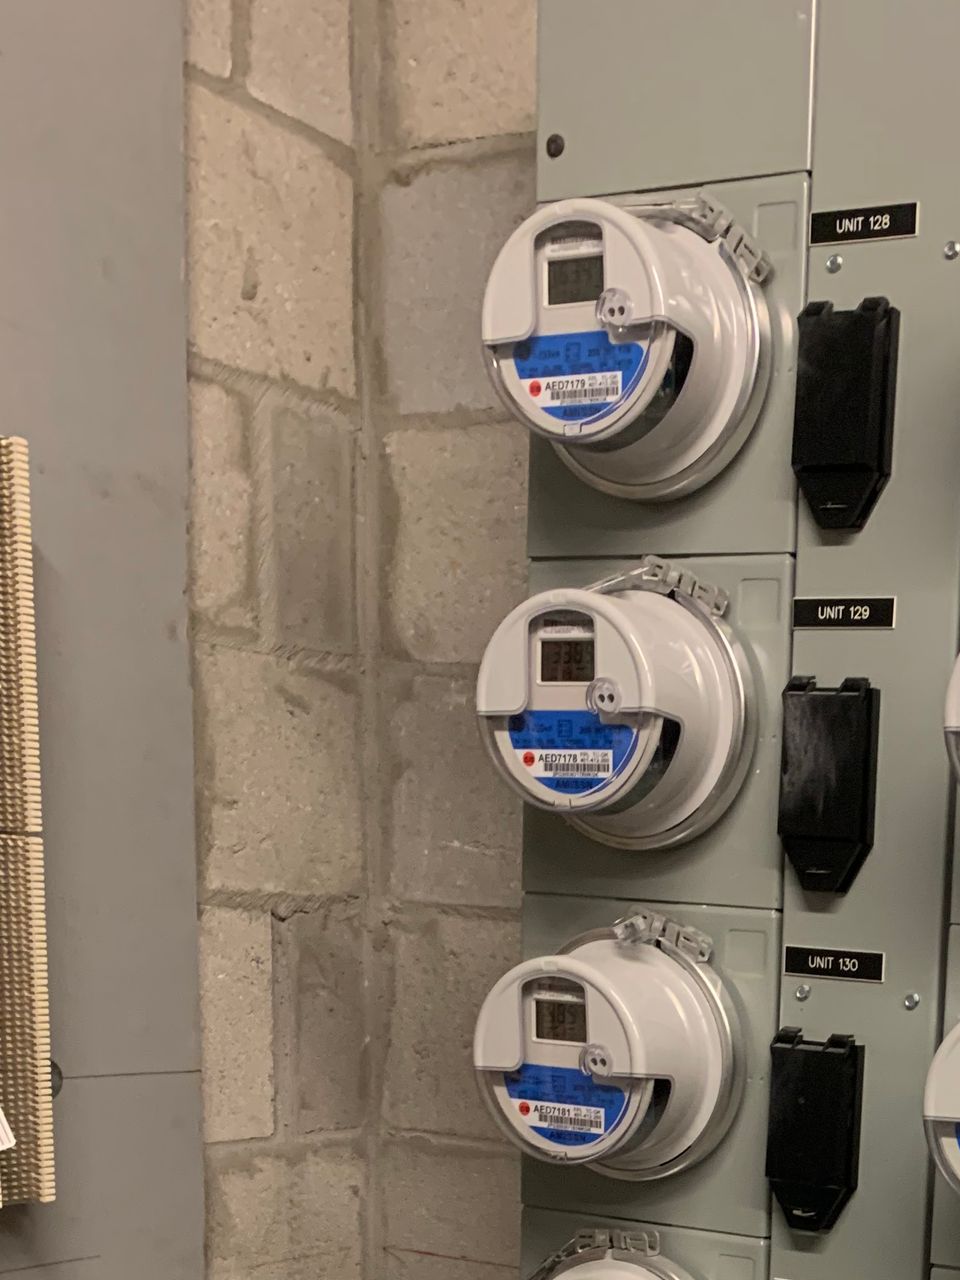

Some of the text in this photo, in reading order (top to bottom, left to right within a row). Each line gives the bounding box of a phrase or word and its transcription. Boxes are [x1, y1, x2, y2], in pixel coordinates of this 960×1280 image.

[837, 214, 890, 233] UNIT 128
[545, 379, 586, 392] AED7179
[818, 605, 870, 620] UNIT 129
[538, 753, 578, 764] AED7178
[809, 955, 859, 971] UNIT 130
[533, 1104, 571, 1117] AED7181
